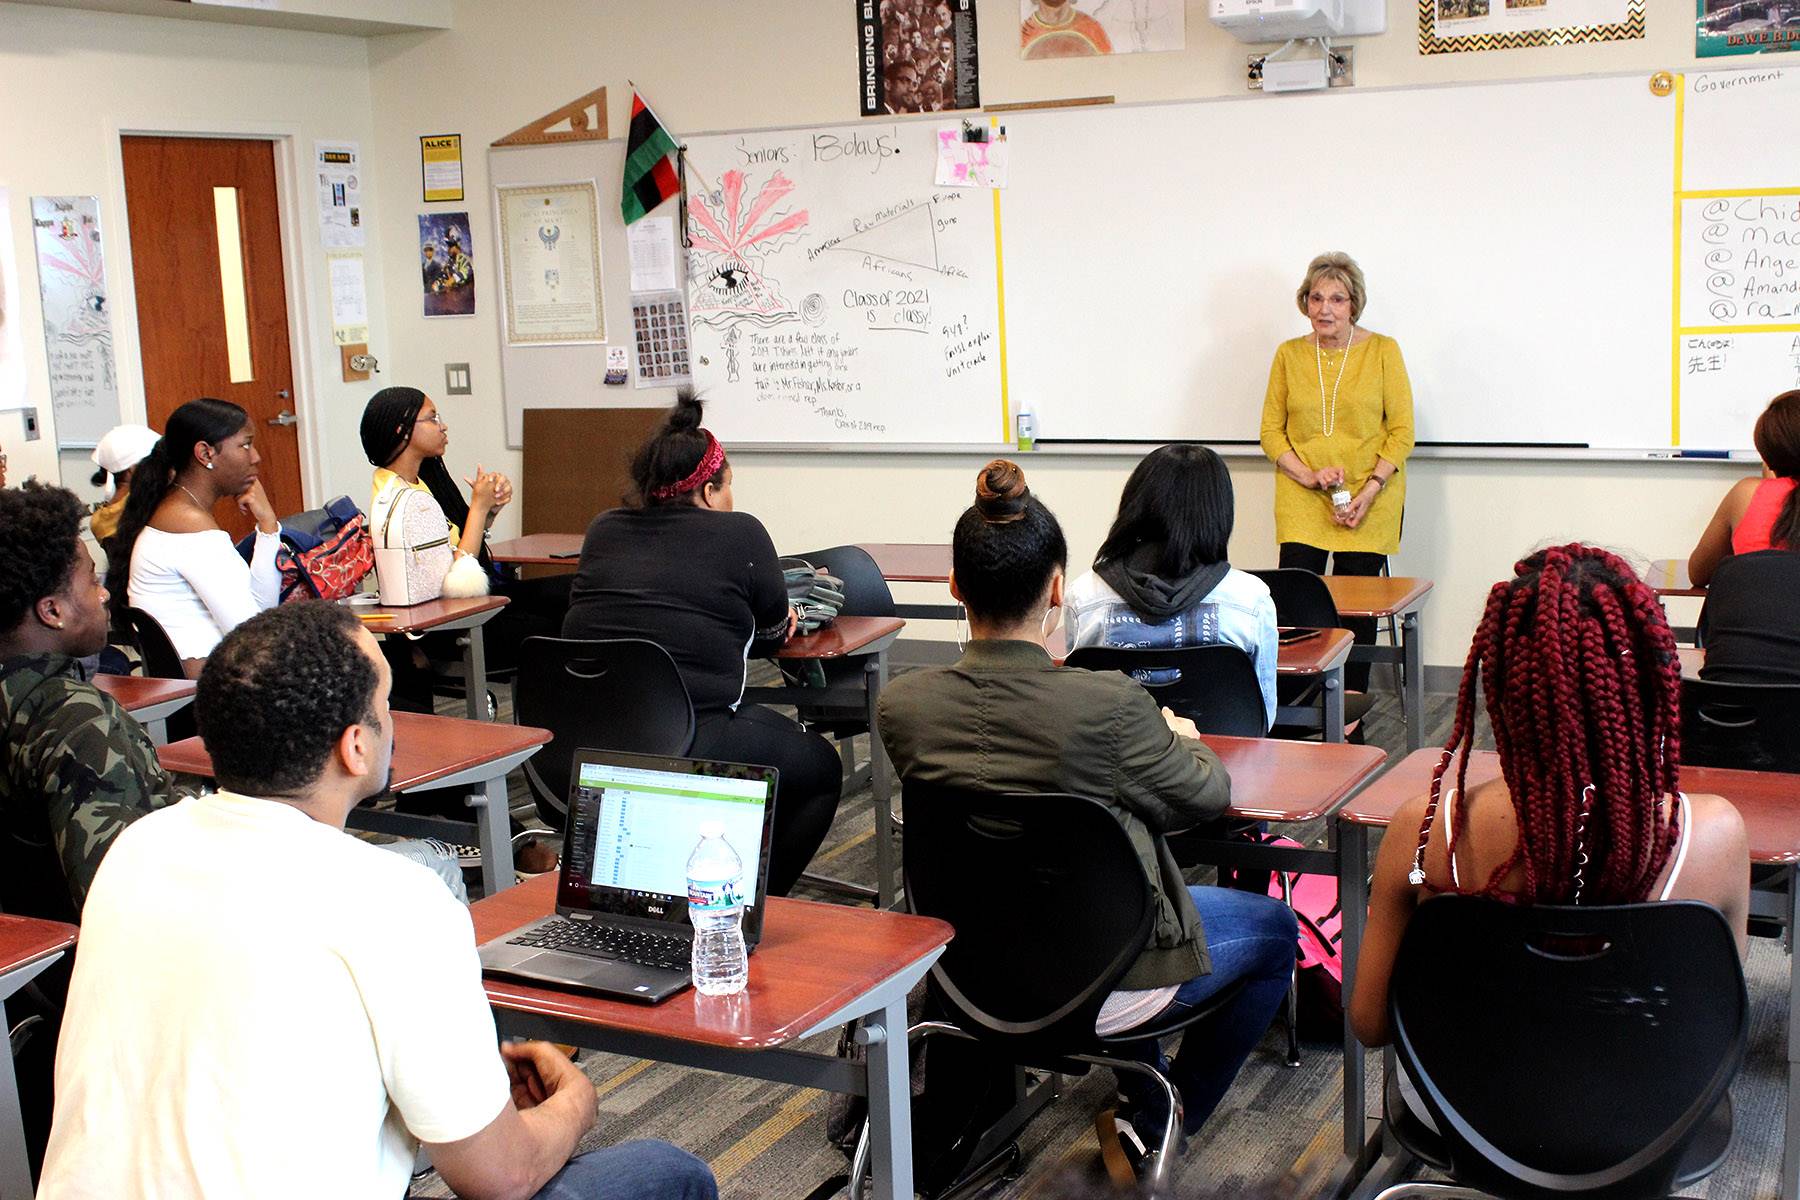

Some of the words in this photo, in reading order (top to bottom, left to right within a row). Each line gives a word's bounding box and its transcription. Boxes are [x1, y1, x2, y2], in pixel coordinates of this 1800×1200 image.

[864, 25, 877, 110] BRINGING
[1694, 71, 1784, 93] Government
[425, 140, 452, 148] ALICE
[896, 289, 929, 306] 2021
[866, 309, 877, 324] is
[647, 905, 665, 915] DELL
